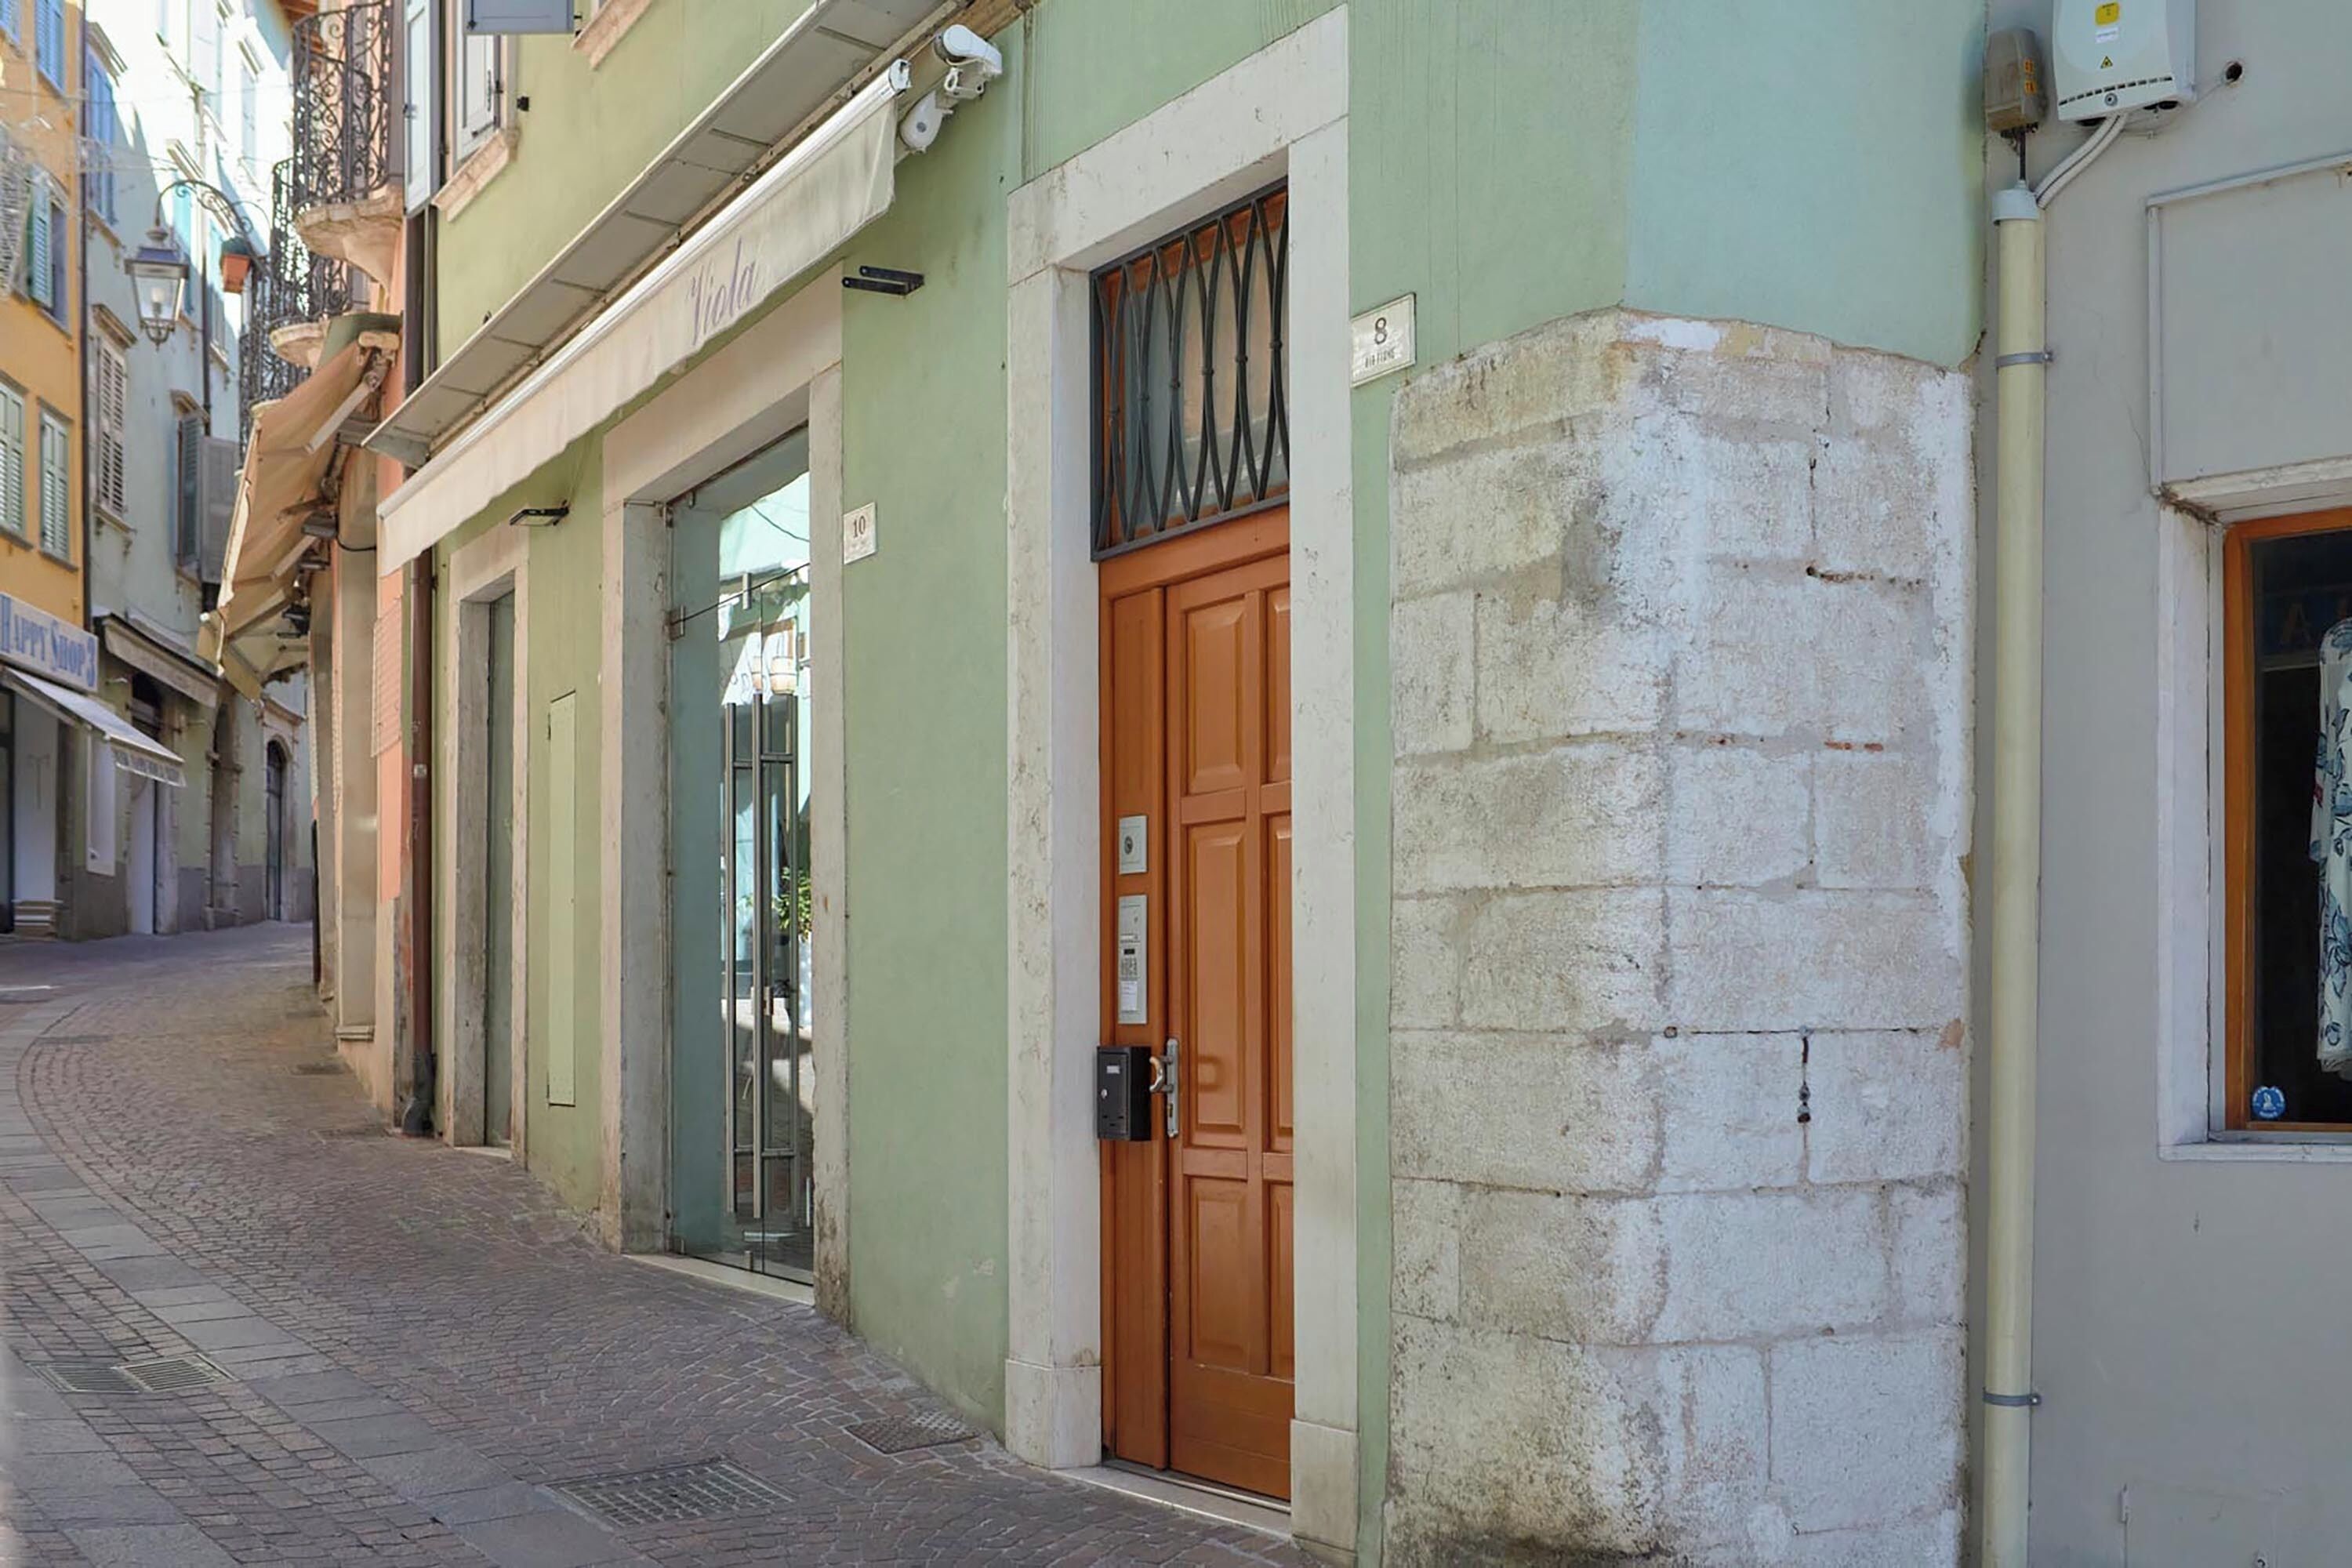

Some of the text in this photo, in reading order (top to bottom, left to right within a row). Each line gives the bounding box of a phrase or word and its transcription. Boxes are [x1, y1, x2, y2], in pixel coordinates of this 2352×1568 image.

[687, 238, 757, 346] Viola
[1374, 317, 1388, 345] 8
[852, 514, 866, 539] 10
